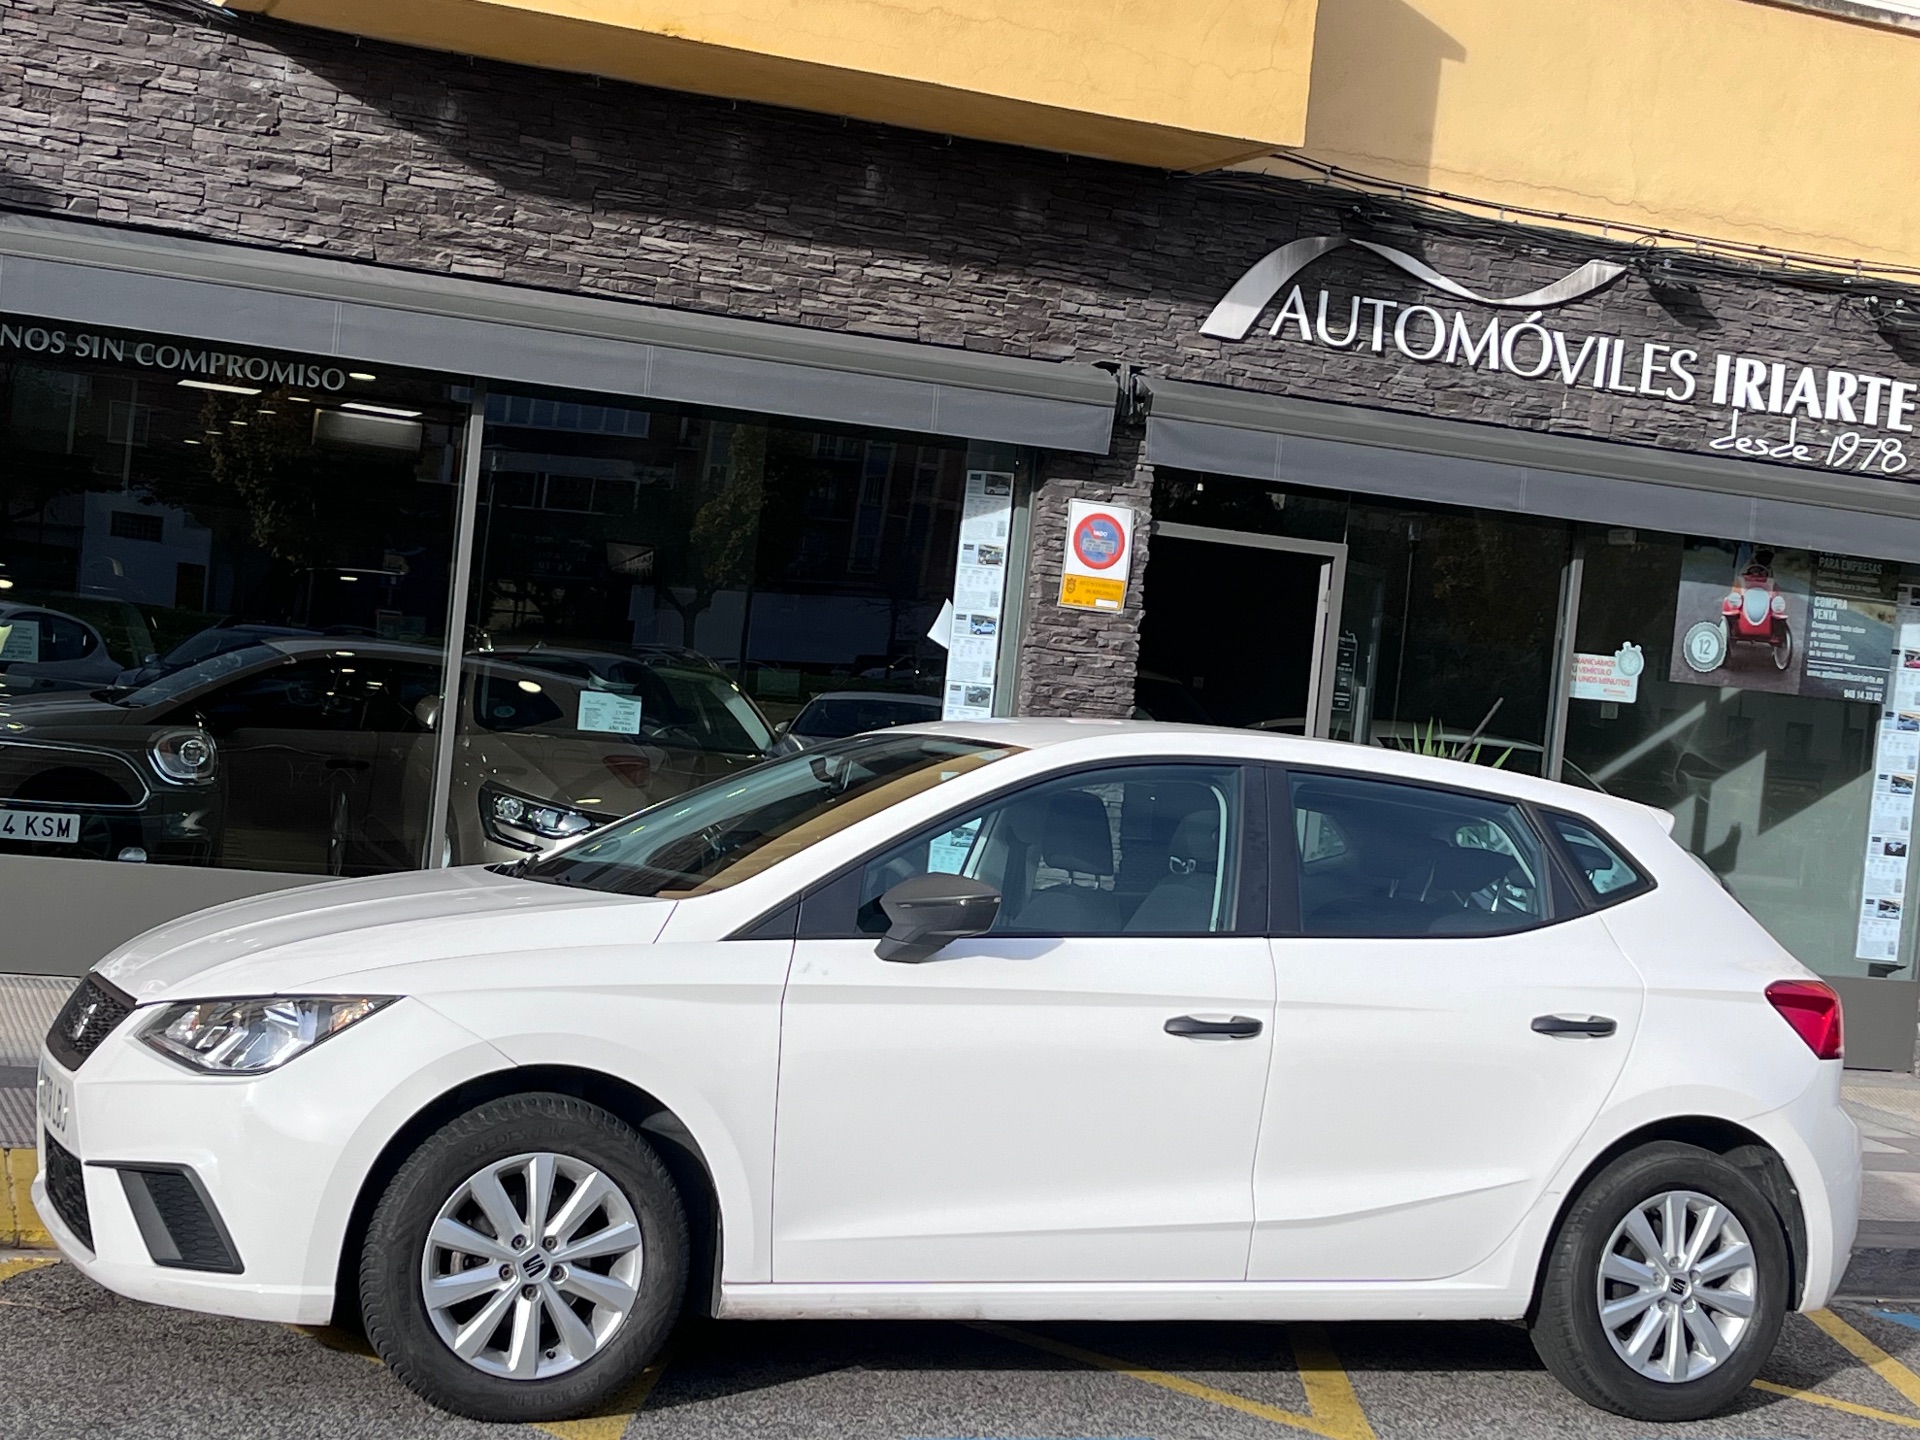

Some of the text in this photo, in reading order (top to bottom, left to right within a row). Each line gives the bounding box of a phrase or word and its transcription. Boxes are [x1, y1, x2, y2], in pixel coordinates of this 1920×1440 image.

[75, 334, 125, 362] SIN
[134, 342, 346, 391] COMPROMISO
[1268, 284, 1918, 433] AUTOMÓVILES IRIARTE
[1709, 409, 1907, 473] desde 1978
[1813, 608, 1838, 621] VENTA
[1814, 596, 1848, 610] COMPRA
[1699, 639, 1711, 655] 12
[3, 814, 71, 838] 4 KSM
